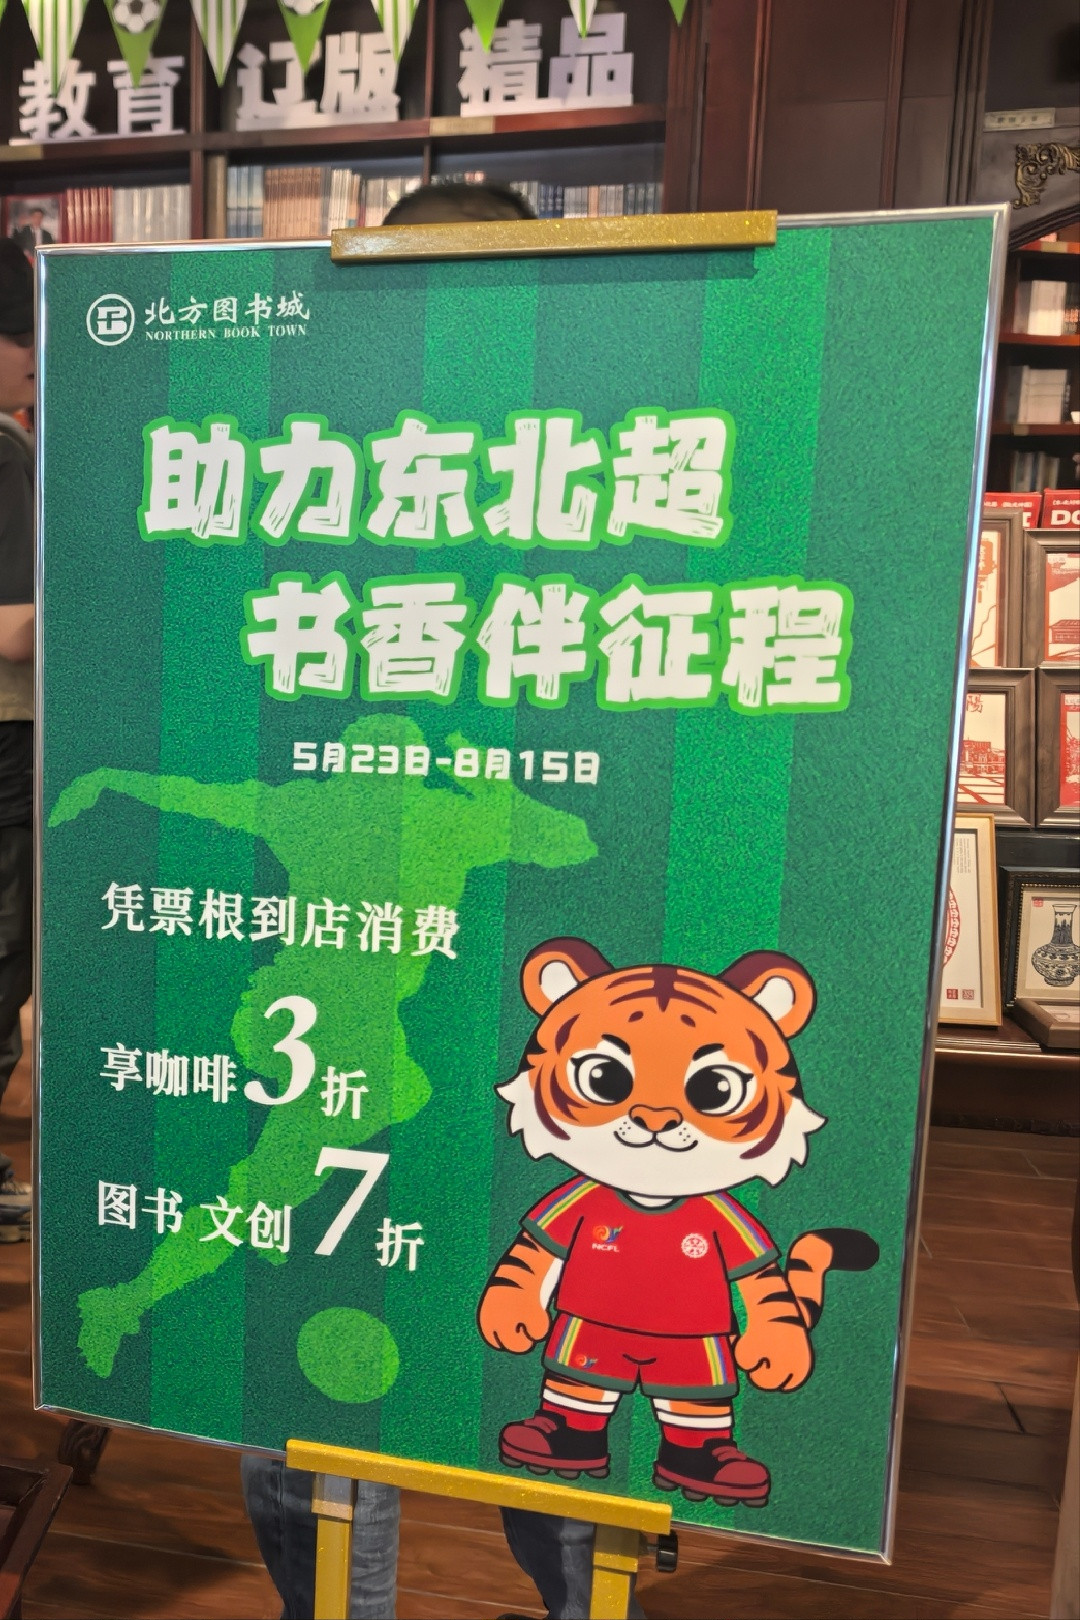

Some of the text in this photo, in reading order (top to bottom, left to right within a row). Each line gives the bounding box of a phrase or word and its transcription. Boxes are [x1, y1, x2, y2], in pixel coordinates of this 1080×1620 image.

[19, 56, 186, 140] 教育
[144, 290, 310, 326] 北方图书城
[145, 323, 308, 342] NORTHERN BOOK TOWN
[142, 414, 732, 545] 助力东北超
[245, 575, 848, 709] 书香伴征程
[292, 740, 602, 786] 5月23日-8月15日
[100, 880, 461, 961] 凭票根到店消费
[99, 995, 370, 1120] 享咖啡3折
[97, 1146, 426, 1272] 图书 文创7折
